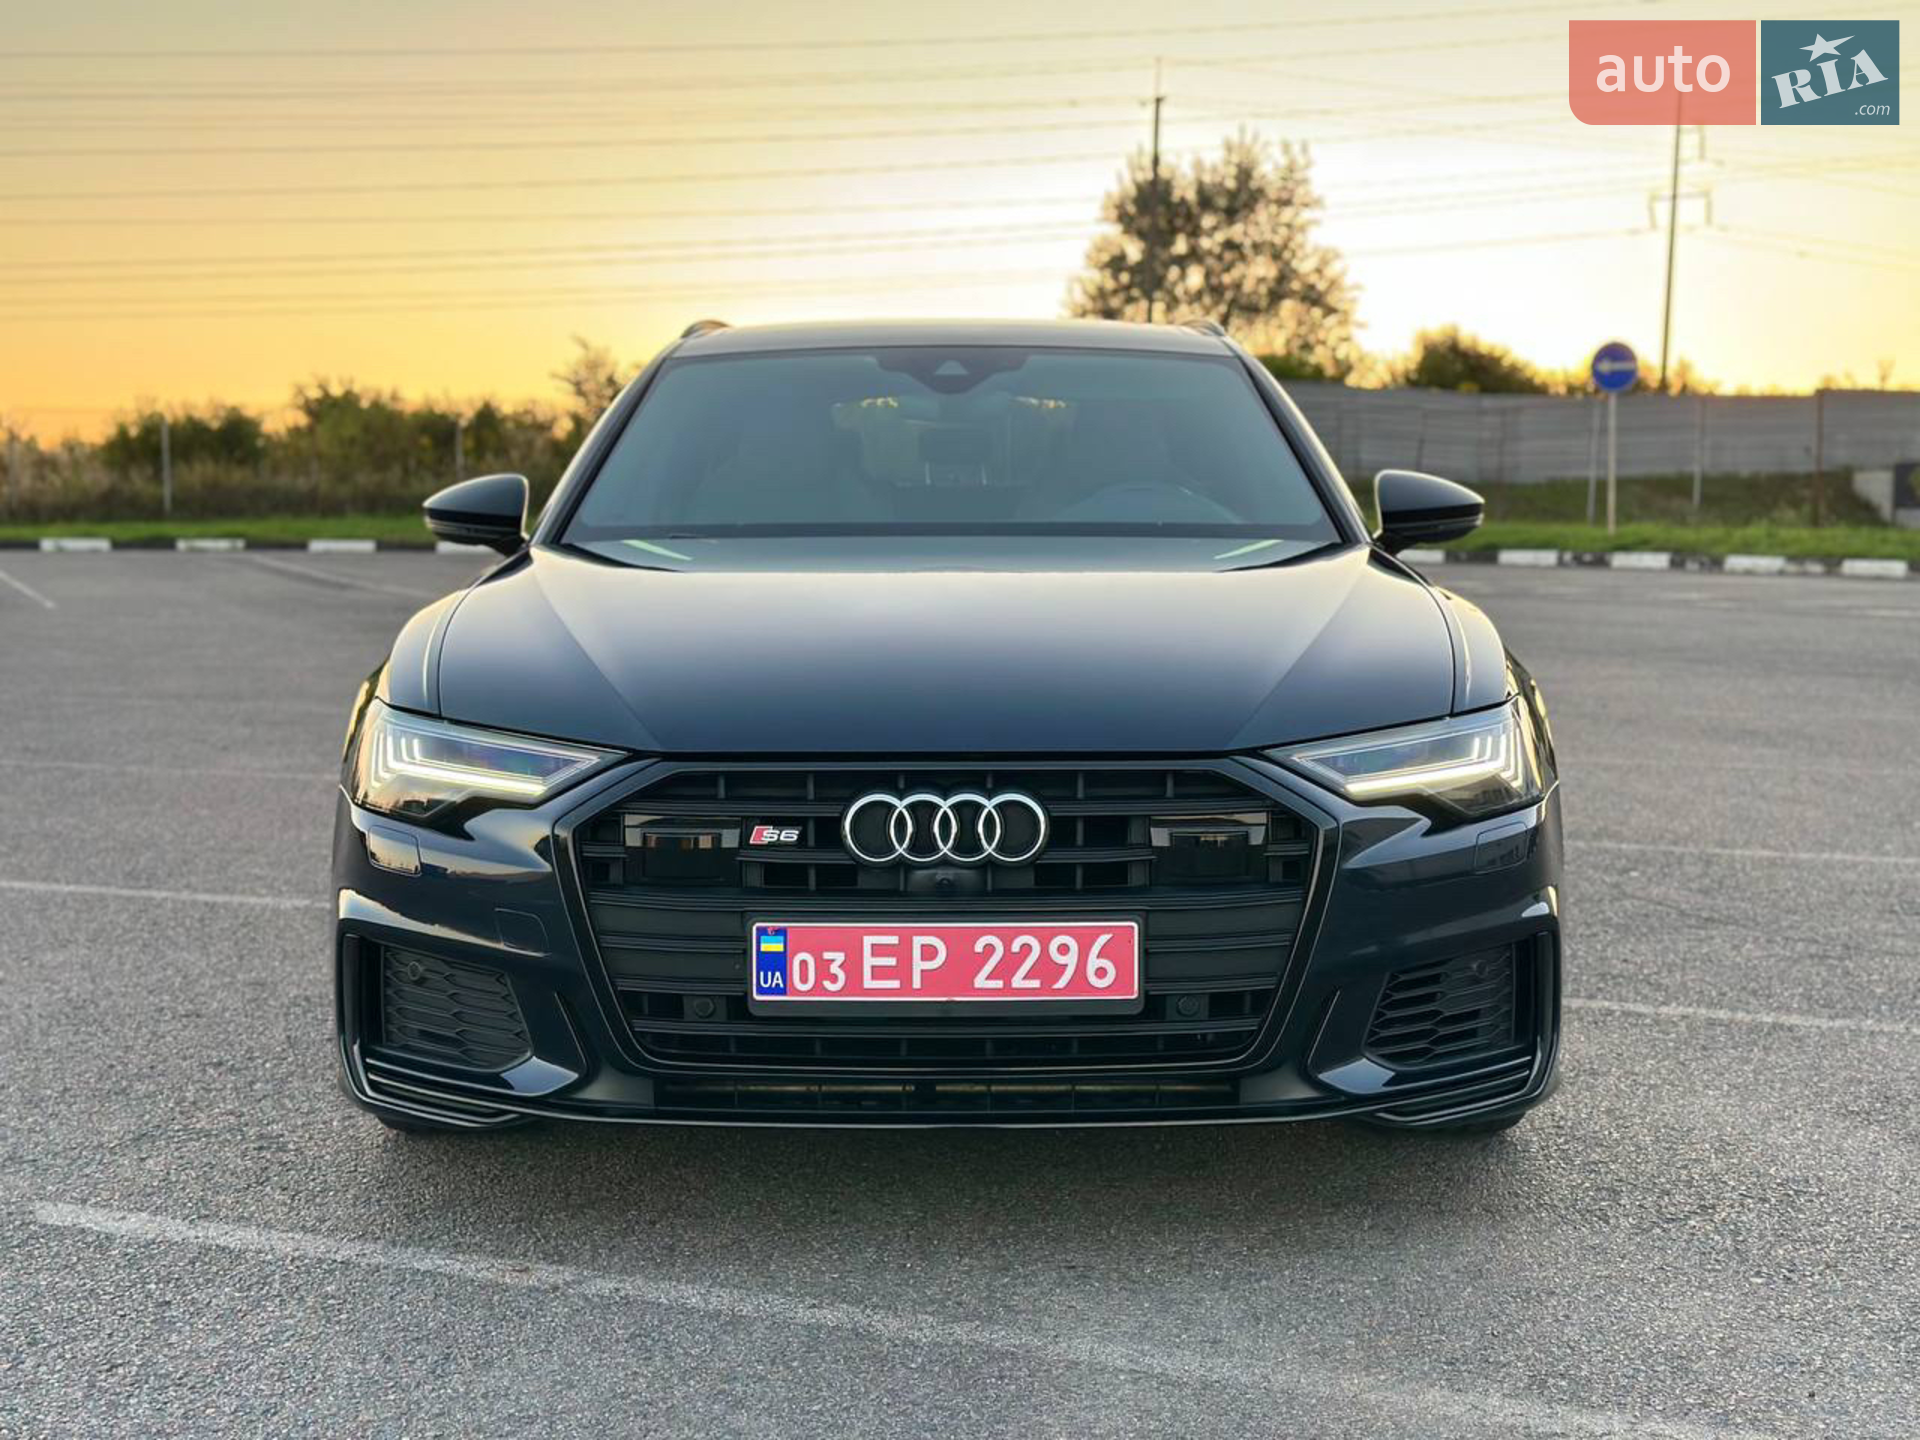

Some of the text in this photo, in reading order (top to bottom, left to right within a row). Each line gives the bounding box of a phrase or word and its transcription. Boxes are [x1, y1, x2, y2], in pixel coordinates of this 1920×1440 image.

[762, 829, 800, 842] S6
[792, 933, 1117, 991] 03 EP 2296
[759, 971, 784, 988] UA
